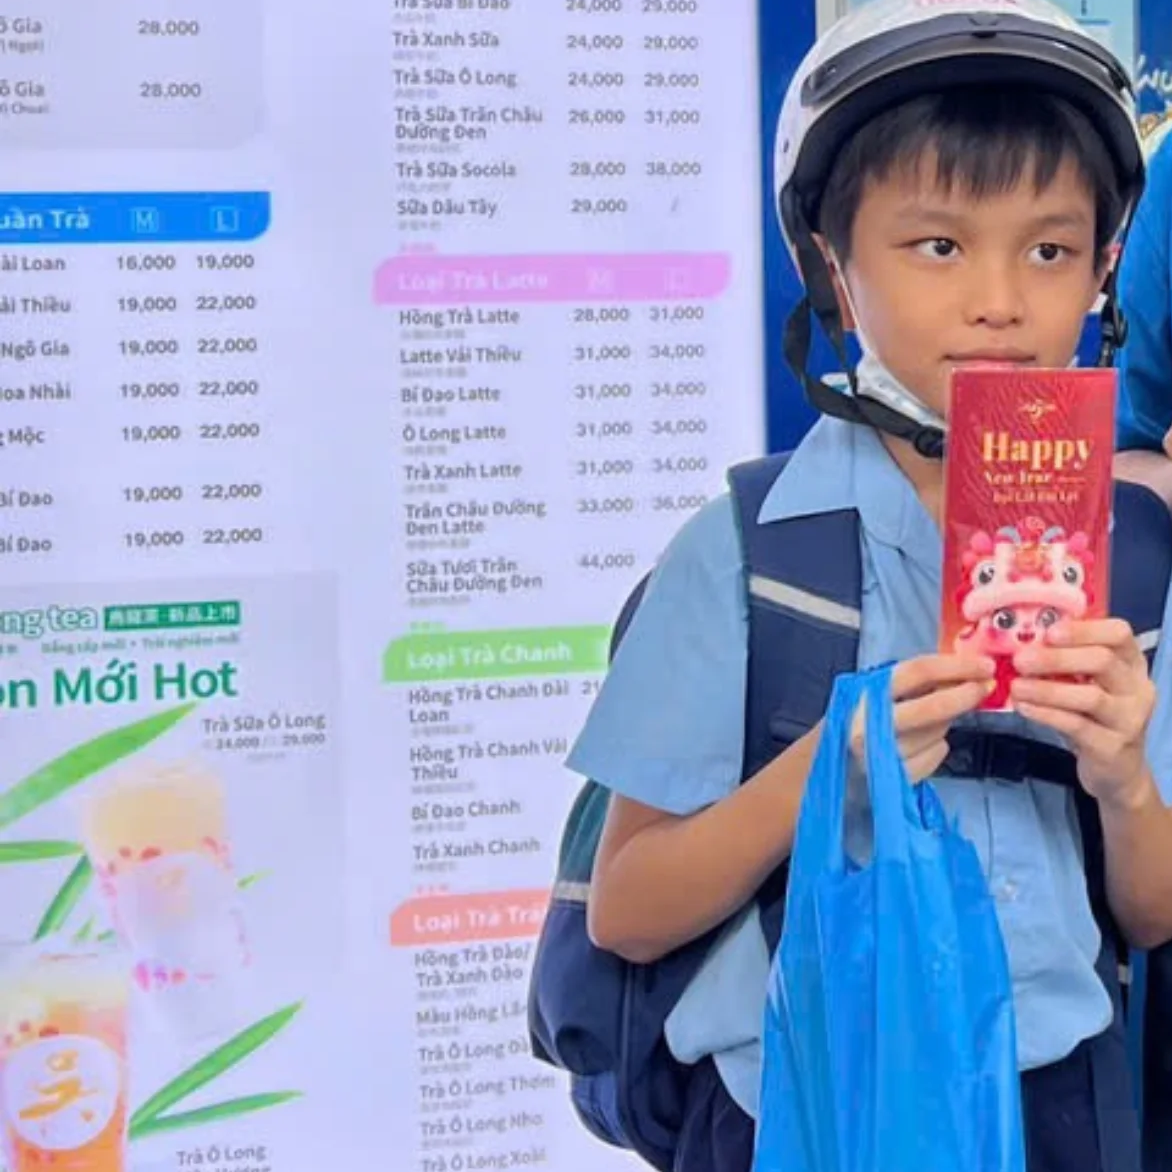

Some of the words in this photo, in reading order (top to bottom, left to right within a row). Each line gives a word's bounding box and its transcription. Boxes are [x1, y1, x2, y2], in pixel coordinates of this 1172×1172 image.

[13, 18, 42, 34] Gia
[138, 20, 200, 36] 28,000
[422, 31, 465, 47] Xanh
[566, 34, 624, 51] 24,000
[643, 35, 699, 51] 29,000
[459, 67, 472, 85] Ô
[476, 71, 517, 88] Long
[568, 72, 624, 88] 24,000
[644, 72, 700, 88] 29,000
[15, 82, 45, 98] Gia
[140, 83, 202, 99] 28,000
[568, 109, 626, 126] 26,000
[644, 109, 700, 126] 31,000
[461, 162, 517, 178] Socola
[570, 161, 626, 179] 28,000
[646, 161, 701, 179] 38,000
[572, 199, 628, 216] 29,000
[50, 207, 90, 229] Trà
[135, 210, 151, 232] M
[22, 257, 66, 271] Loan
[117, 255, 176, 271] 16,000
[196, 254, 255, 270] 19,000
[118, 297, 177, 313] 19,000
[196, 295, 257, 312] 22,000
[478, 309, 520, 325] Latte
[574, 308, 630, 325] 28,000
[650, 306, 704, 323] 31,000
[1, 340, 36, 361] Ngô
[41, 341, 70, 356] Gia
[119, 340, 178, 356] 19,000
[197, 338, 258, 354] 22,000
[401, 348, 443, 364] Latte
[574, 346, 631, 362] 31,000
[650, 345, 705, 361] 34,000
[120, 382, 179, 399] 19,000
[198, 381, 259, 397] 22,000
[459, 386, 501, 402] Latte
[574, 384, 632, 400] 31,000
[651, 382, 706, 398] 34,000
[9, 427, 45, 446] Mộc
[121, 425, 181, 443] 19,000
[200, 423, 260, 440] 22,000
[403, 423, 415, 441] Ô
[420, 426, 461, 444] Long
[465, 424, 506, 440] Latte
[576, 422, 633, 438] 31,000
[651, 419, 707, 435] 34,000
[983, 431, 1091, 471] Happy
[434, 463, 476, 480] Xanh
[480, 463, 522, 479] Latte
[577, 460, 633, 476] 31,000
[652, 457, 707, 474] 34,000
[123, 486, 183, 503] 19,000
[201, 484, 263, 501] 22,000
[578, 498, 634, 514] 33,000
[442, 519, 486, 535] Latte
[125, 531, 184, 548] 19,000
[202, 528, 263, 545] 22,000
[579, 554, 635, 570] 44,000
[47, 604, 98, 631] tea
[502, 644, 572, 664] Chanh
[53, 658, 138, 705] Mới
[153, 659, 238, 700] Hot
[486, 682, 538, 700] Chanh
[268, 712, 281, 728] Ô
[284, 714, 326, 731] Long
[409, 708, 450, 724] Loan
[487, 740, 540, 758] Chanh
[468, 799, 520, 817] Chanh
[443, 840, 484, 857] Xanh
[488, 836, 540, 854] Chanh
[446, 967, 488, 985] Xanh
[465, 1041, 504, 1059] Long
[466, 1076, 505, 1095] Long
[467, 1114, 507, 1133] Long
[511, 1112, 544, 1128] Nho
[224, 1145, 267, 1162] Long
[467, 1151, 509, 1171] Long
